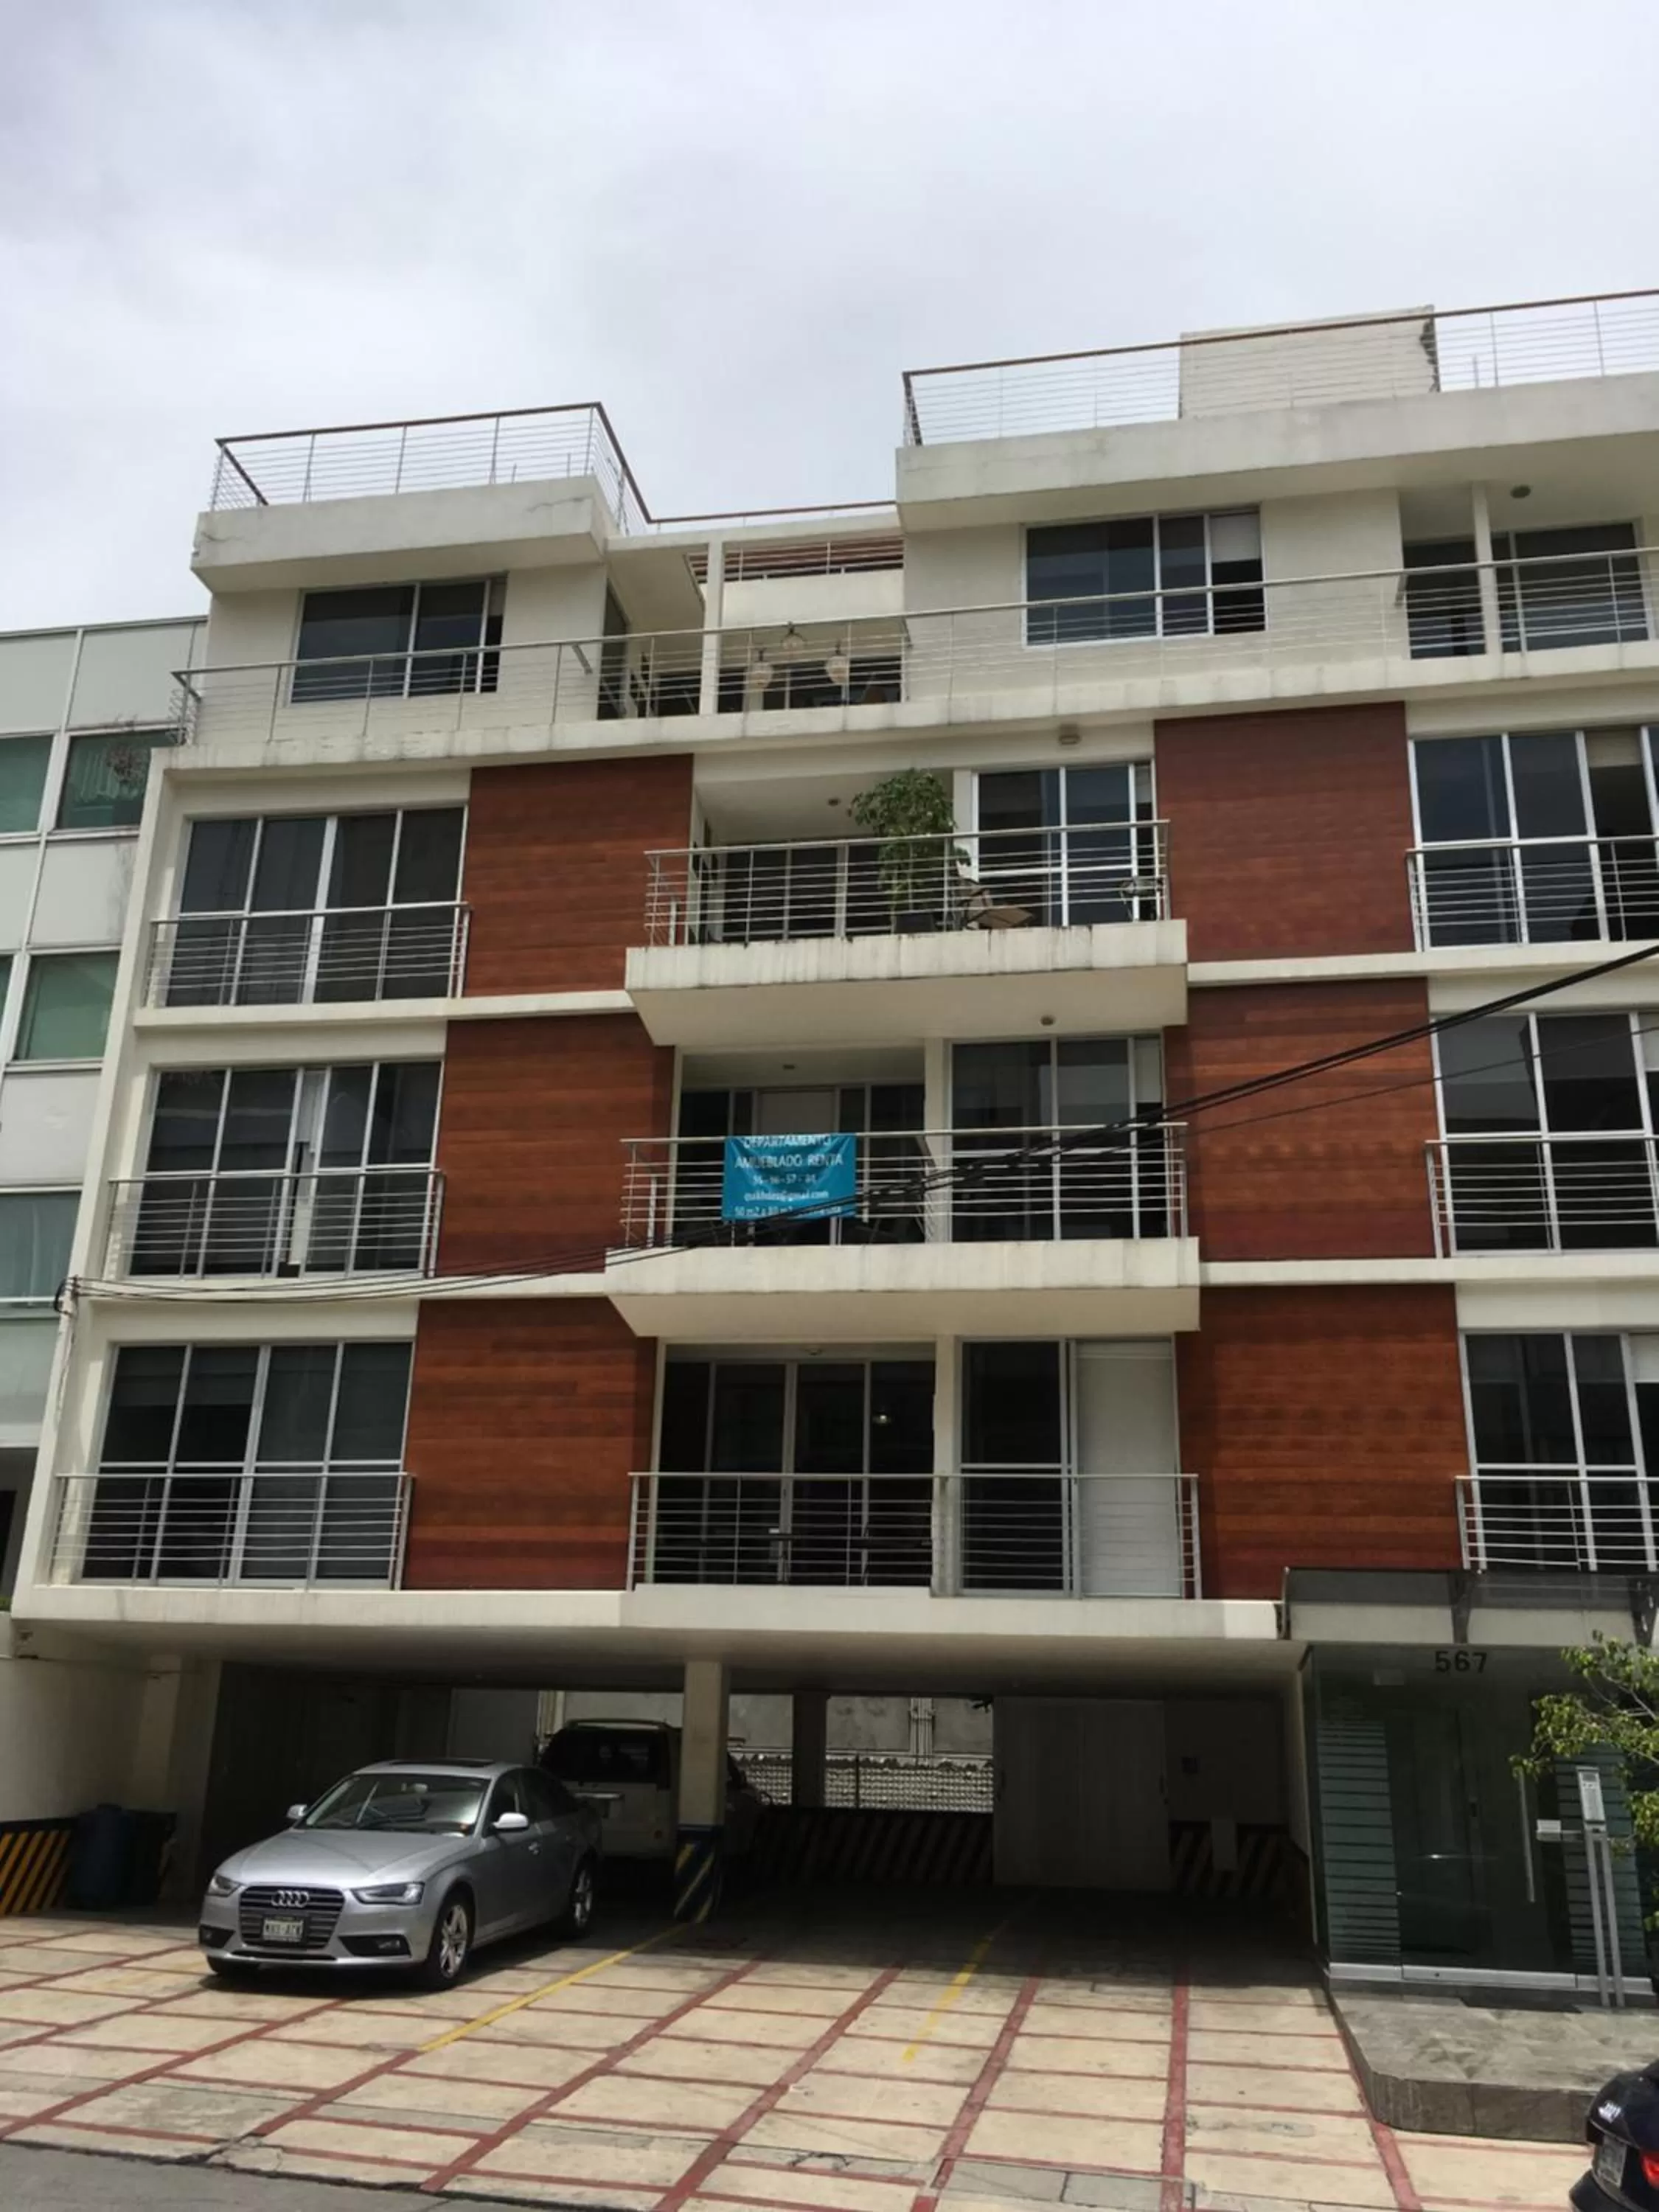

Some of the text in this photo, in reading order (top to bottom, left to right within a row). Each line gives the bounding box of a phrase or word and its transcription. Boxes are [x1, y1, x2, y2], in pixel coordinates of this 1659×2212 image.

[743, 1133, 832, 1148] DEPARTAMENTO
[734, 1152, 844, 1169] AMUEBLADO RENTA
[1435, 1649, 1487, 1674] 567
